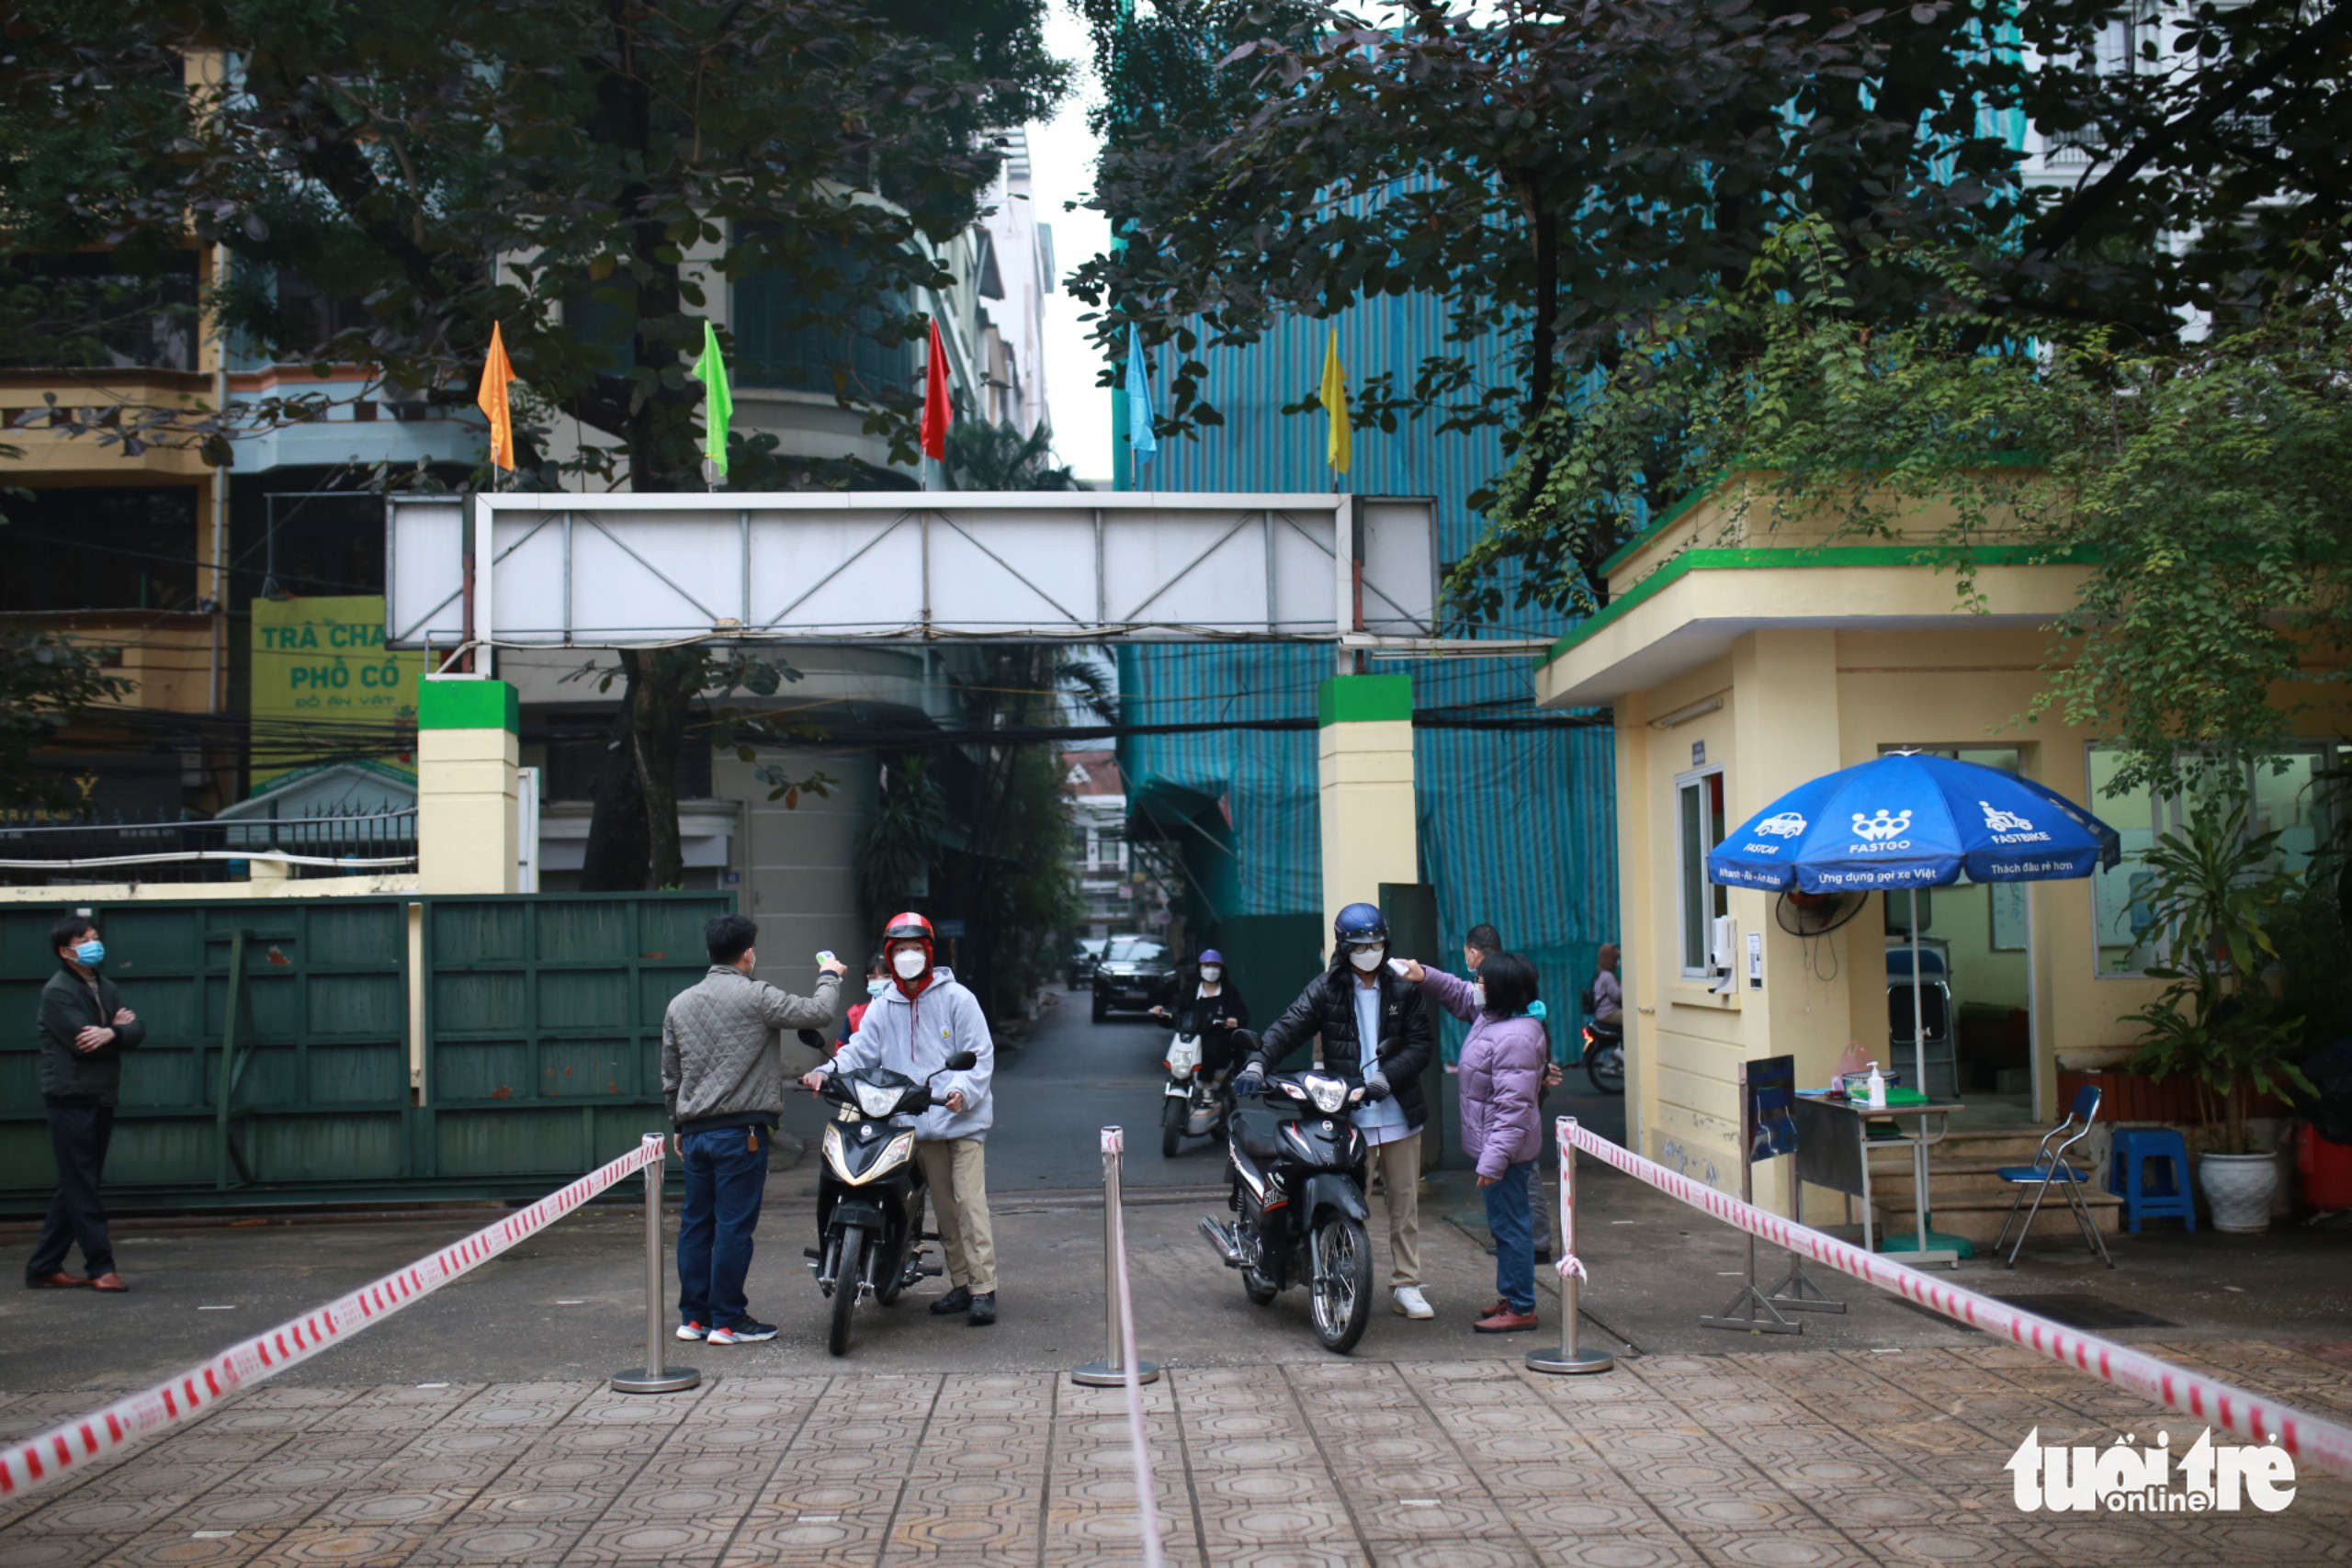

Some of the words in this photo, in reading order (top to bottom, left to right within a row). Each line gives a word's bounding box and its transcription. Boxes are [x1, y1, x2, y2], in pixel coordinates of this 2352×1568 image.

[261, 620, 319, 649] TRÀ
[1991, 831, 2051, 844] FASTBIKE
[1744, 842, 1780, 855] FASTCAR
[1849, 840, 1911, 853] FASTGO
[1818, 871, 1843, 884] Ứng
[1846, 872, 1873, 883] dụng
[1878, 870, 1894, 884] gọi
[1914, 869, 1936, 879] Việt
